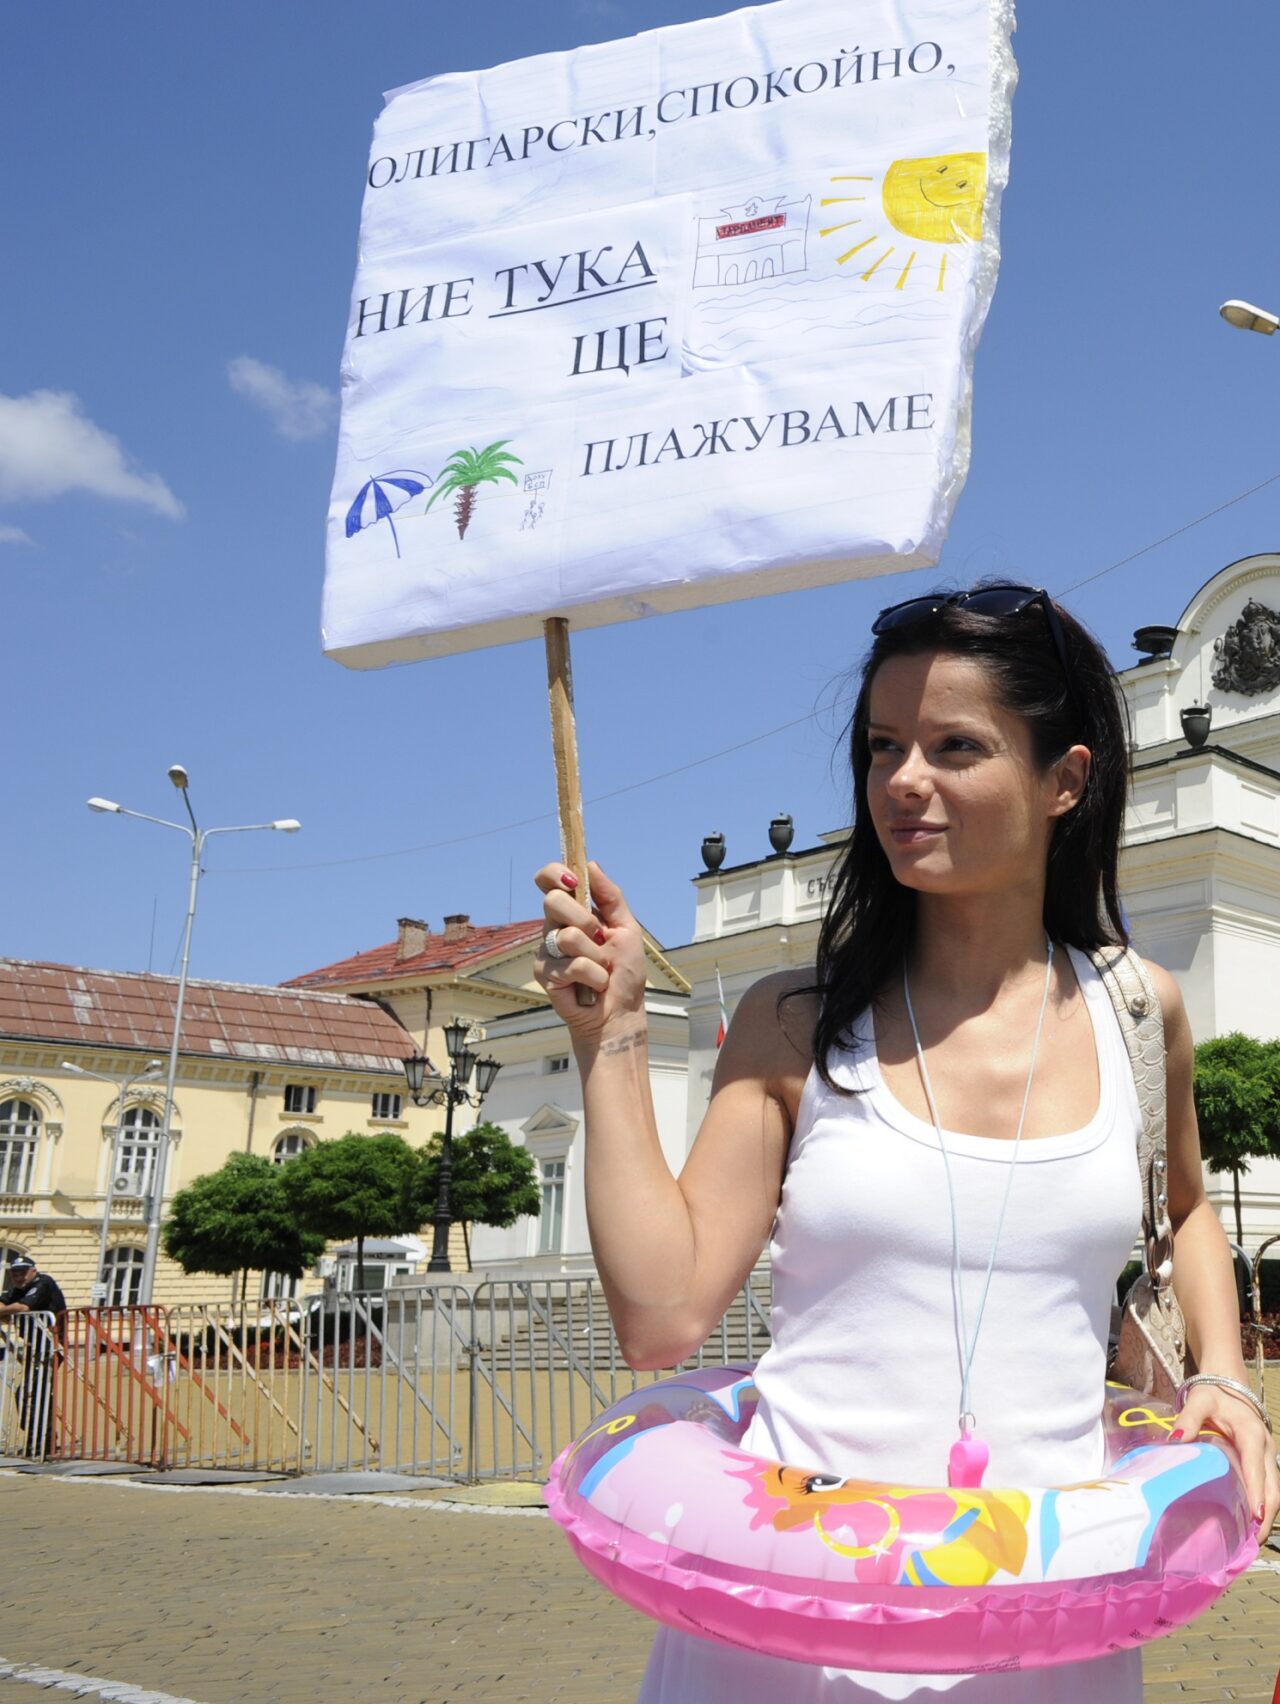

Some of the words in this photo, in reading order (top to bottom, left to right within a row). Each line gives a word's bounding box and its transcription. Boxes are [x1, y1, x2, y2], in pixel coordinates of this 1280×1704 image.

[354, 277, 474, 338] НИЕ
[495, 240, 657, 310] ТУКА
[568, 317, 668, 376] ЩЕ
[581, 394, 934, 476] ПЛАЖУВАМЕ
